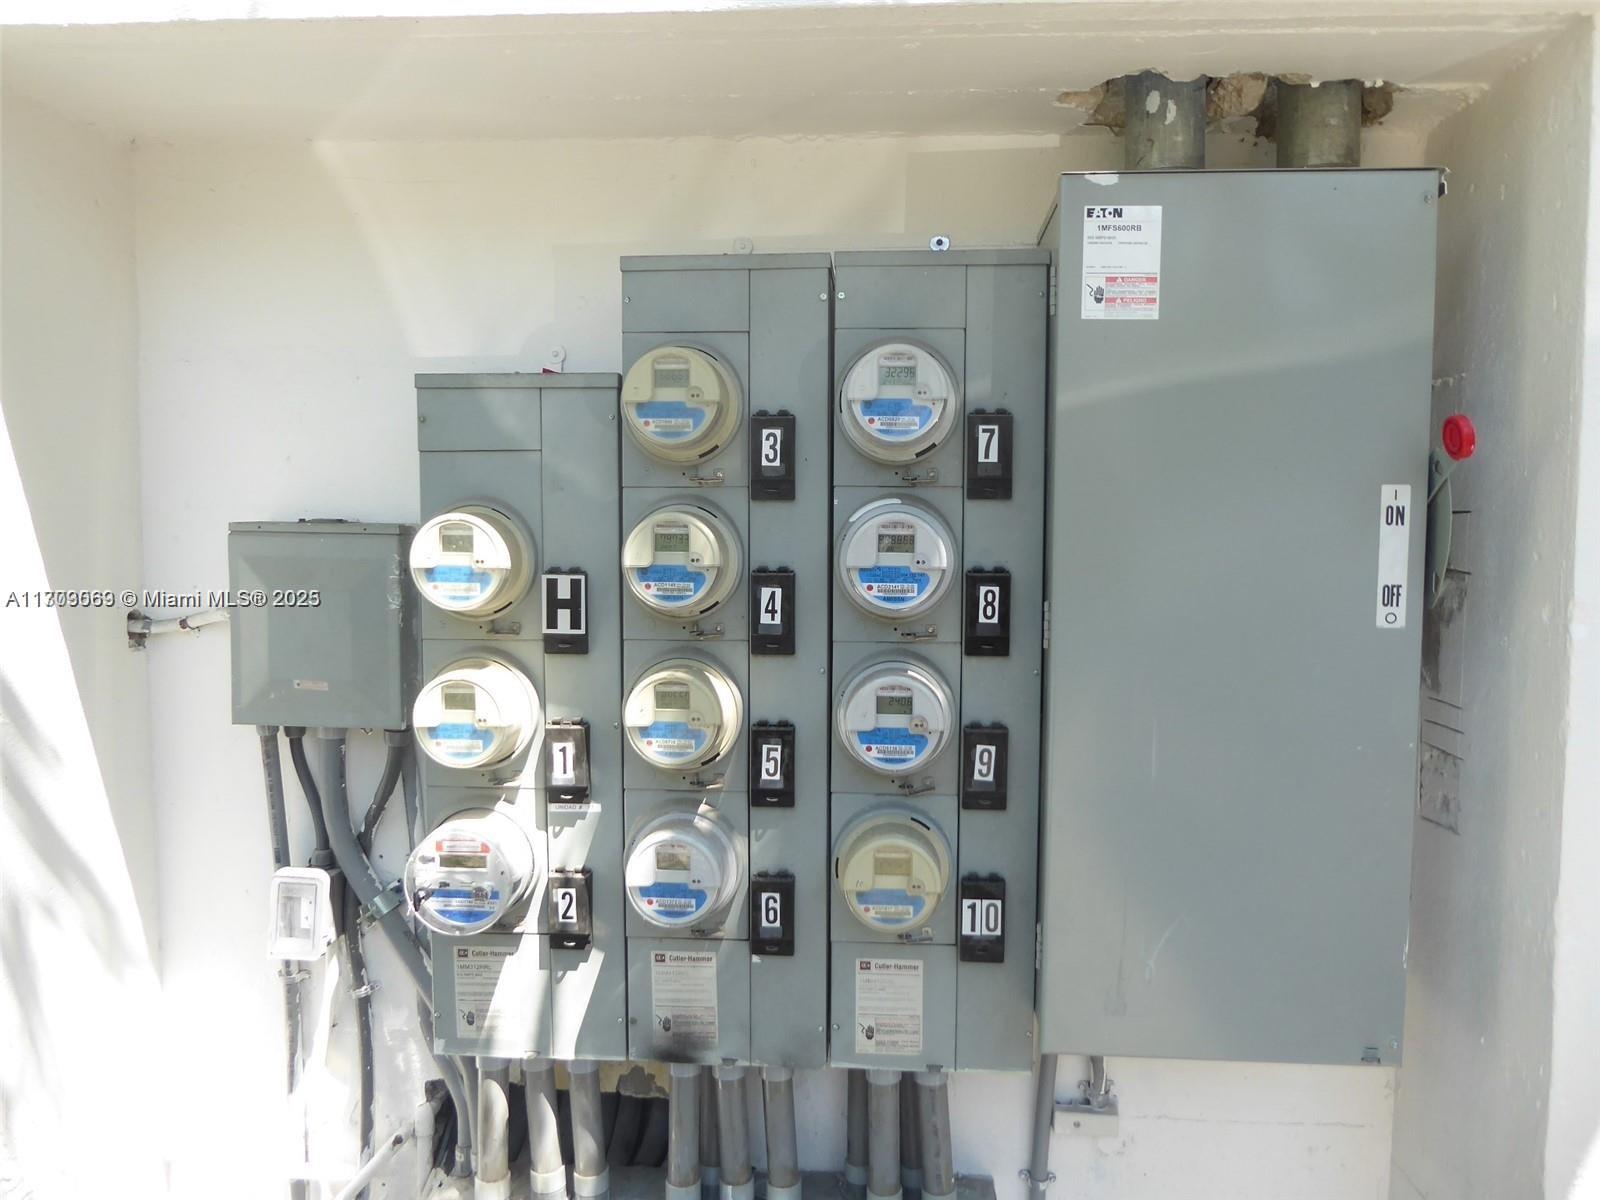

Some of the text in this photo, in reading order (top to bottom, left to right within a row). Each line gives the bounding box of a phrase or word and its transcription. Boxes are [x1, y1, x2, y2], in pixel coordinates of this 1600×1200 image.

[765, 432, 778, 463] 3
[981, 428, 996, 459] 7
[1385, 505, 1405, 526] ON
[546, 578, 582, 629] H
[764, 591, 778, 621] 4
[982, 589, 996, 620] 8
[1382, 584, 1402, 607] OFF
[558, 745, 568, 774] 1
[765, 747, 779, 777] 5
[978, 748, 993, 777] 9
[561, 892, 574, 920] 2
[765, 895, 778, 924] 6
[967, 902, 999, 933] 10
